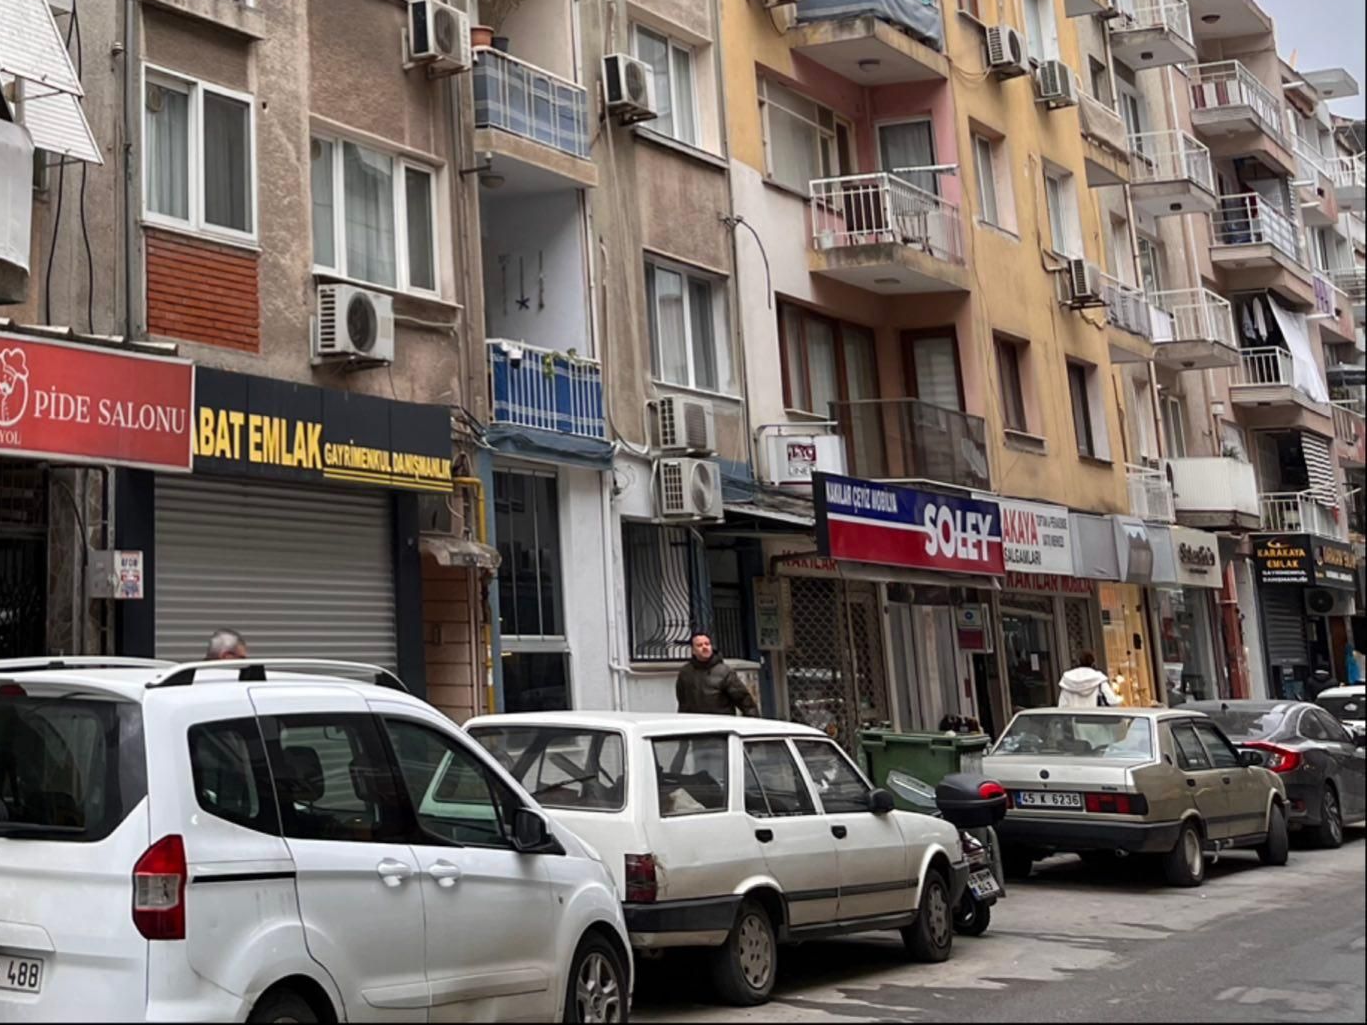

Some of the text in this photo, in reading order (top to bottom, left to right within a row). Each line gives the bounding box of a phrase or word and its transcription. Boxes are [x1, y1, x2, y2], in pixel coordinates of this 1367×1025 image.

[34, 385, 91, 423] PİDE
[98, 399, 186, 435] SALONU
[249, 414, 323, 470] EMLAK
[324, 439, 392, 472] GAYRİMENKUL
[392, 451, 451, 483] DANIŞMANLIK
[924, 503, 992, 562] SOLEY
[7, 960, 39, 988] 488
